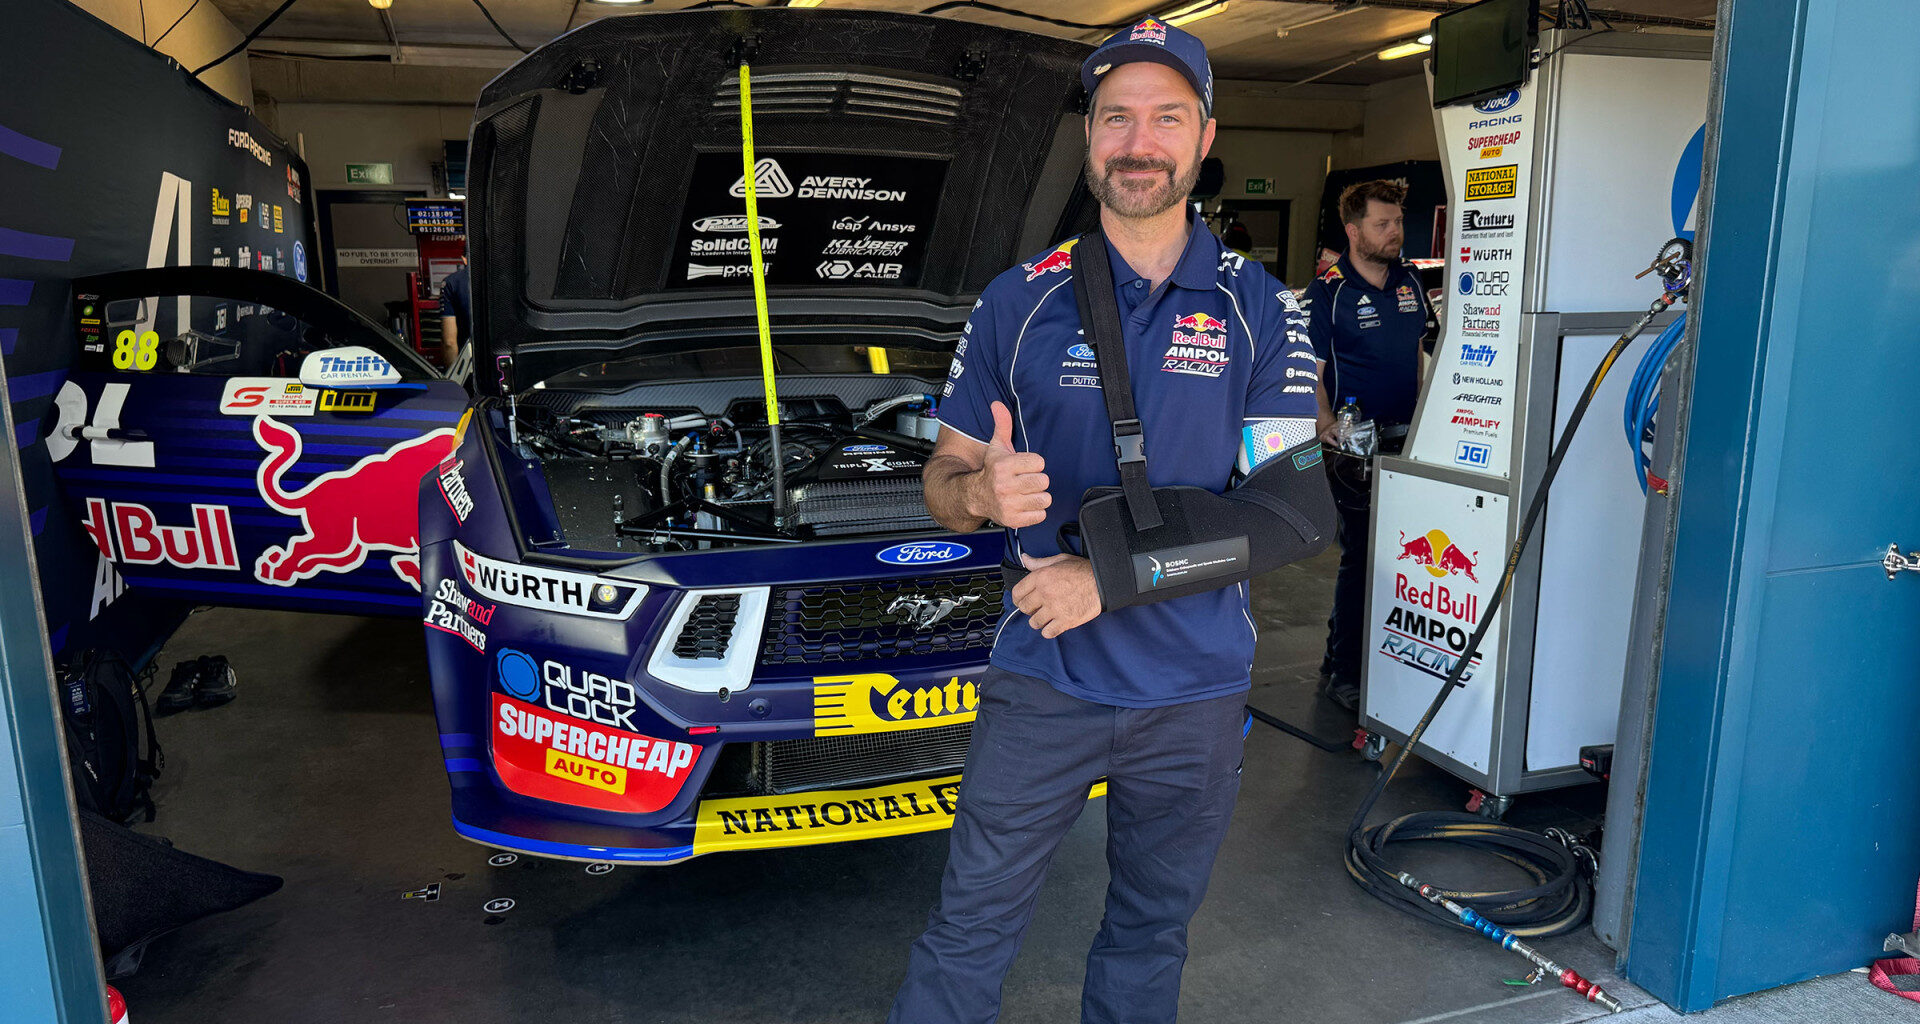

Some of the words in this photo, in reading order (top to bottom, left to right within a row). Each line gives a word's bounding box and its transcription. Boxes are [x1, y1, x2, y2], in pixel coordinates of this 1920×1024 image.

[1469, 115, 1522, 130] RACING
[228, 128, 249, 149] FORD
[1468, 130, 1521, 150] SUPERCHEAP
[1482, 149, 1500, 157] AUTO
[800, 176, 872, 189] AVERY
[1468, 169, 1515, 183] NATIONAL
[798, 187, 907, 201] DENNISON
[1469, 183, 1512, 196] STORAGE
[832, 220, 862, 232] leap
[868, 221, 916, 233] Ansys
[1462, 210, 1514, 231] Century
[691, 238, 778, 251] SolidCM
[827, 235, 909, 250] KLÜBER
[822, 247, 901, 256] LUBRICATION
[1473, 249, 1512, 261] WÜRTH
[856, 262, 903, 274] AIR
[1476, 271, 1510, 283] QUAD
[1475, 284, 1510, 296] LOCK
[1462, 316, 1500, 329] Partners
[1172, 331, 1200, 346] Red
[1200, 333, 1226, 349] Bull
[112, 330, 160, 371] 88
[1165, 346, 1230, 362] AMPOL
[1460, 344, 1498, 367] Thrifty
[320, 355, 391, 376] Thrifty
[1162, 360, 1225, 374] RACING
[321, 372, 339, 380] CAR
[1072, 377, 1097, 385] DUTTO
[1462, 376, 1474, 384] NEW
[1475, 377, 1503, 386] HOLLAND
[1458, 393, 1502, 405] FREIGHTER
[1458, 418, 1500, 429] AMPLIFY
[1463, 428, 1484, 436] Premium
[1485, 430, 1497, 438] Fuels
[1458, 446, 1488, 464] JGI
[440, 459, 474, 522] Partners
[112, 501, 240, 570] Bull
[897, 544, 953, 562] Ford
[478, 563, 584, 607] WÜRTH
[1395, 573, 1434, 610] Red
[1437, 585, 1478, 625] Bull
[424, 600, 487, 651] Partners
[543, 660, 636, 707] QUAD
[545, 685, 639, 732] LOCK
[499, 703, 693, 778] SUPERCHEAP
[553, 758, 617, 785] AUTO
[717, 792, 936, 835] NATIONAL
